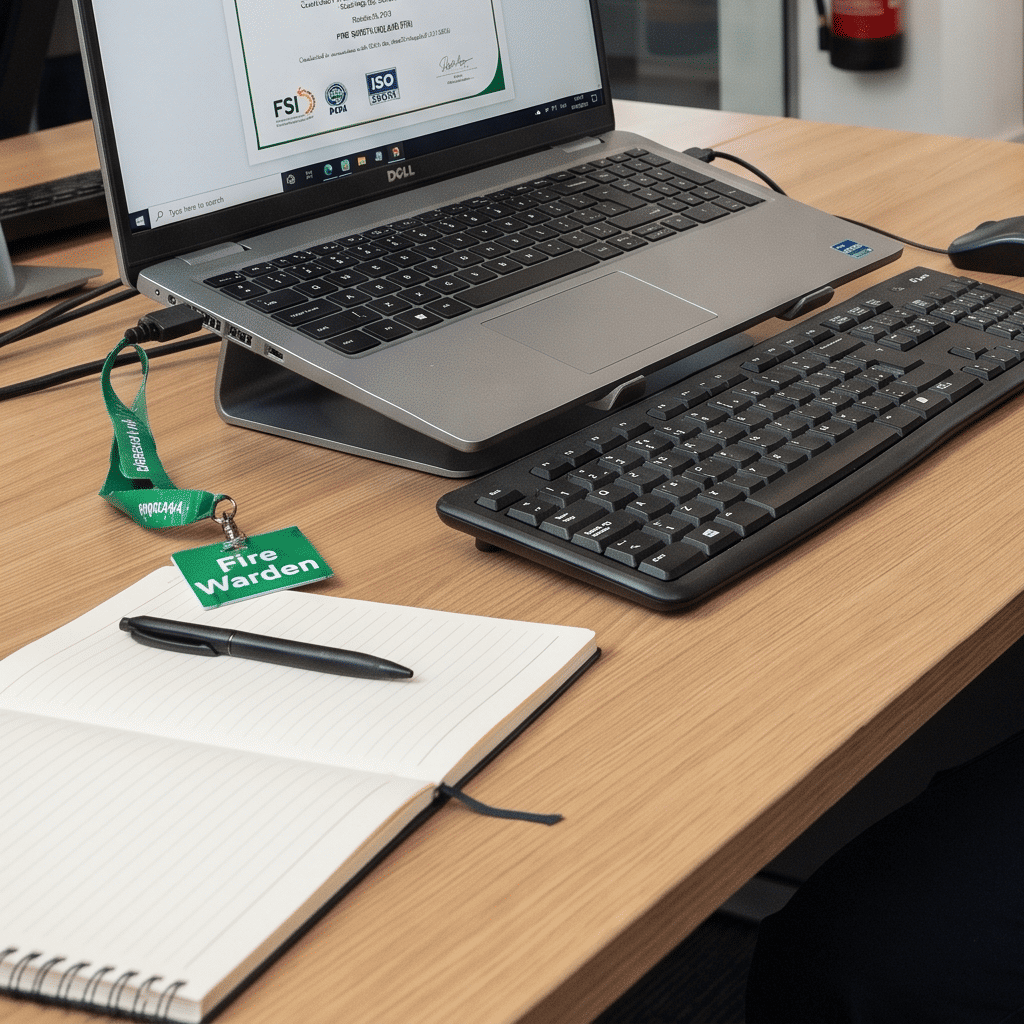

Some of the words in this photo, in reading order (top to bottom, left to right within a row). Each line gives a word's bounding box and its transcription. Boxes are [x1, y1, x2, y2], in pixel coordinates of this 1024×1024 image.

[371, 73, 395, 90] ISO
[273, 95, 299, 118] FSI
[216, 549, 278, 574] Fire
[194, 559, 320, 596] Warden
